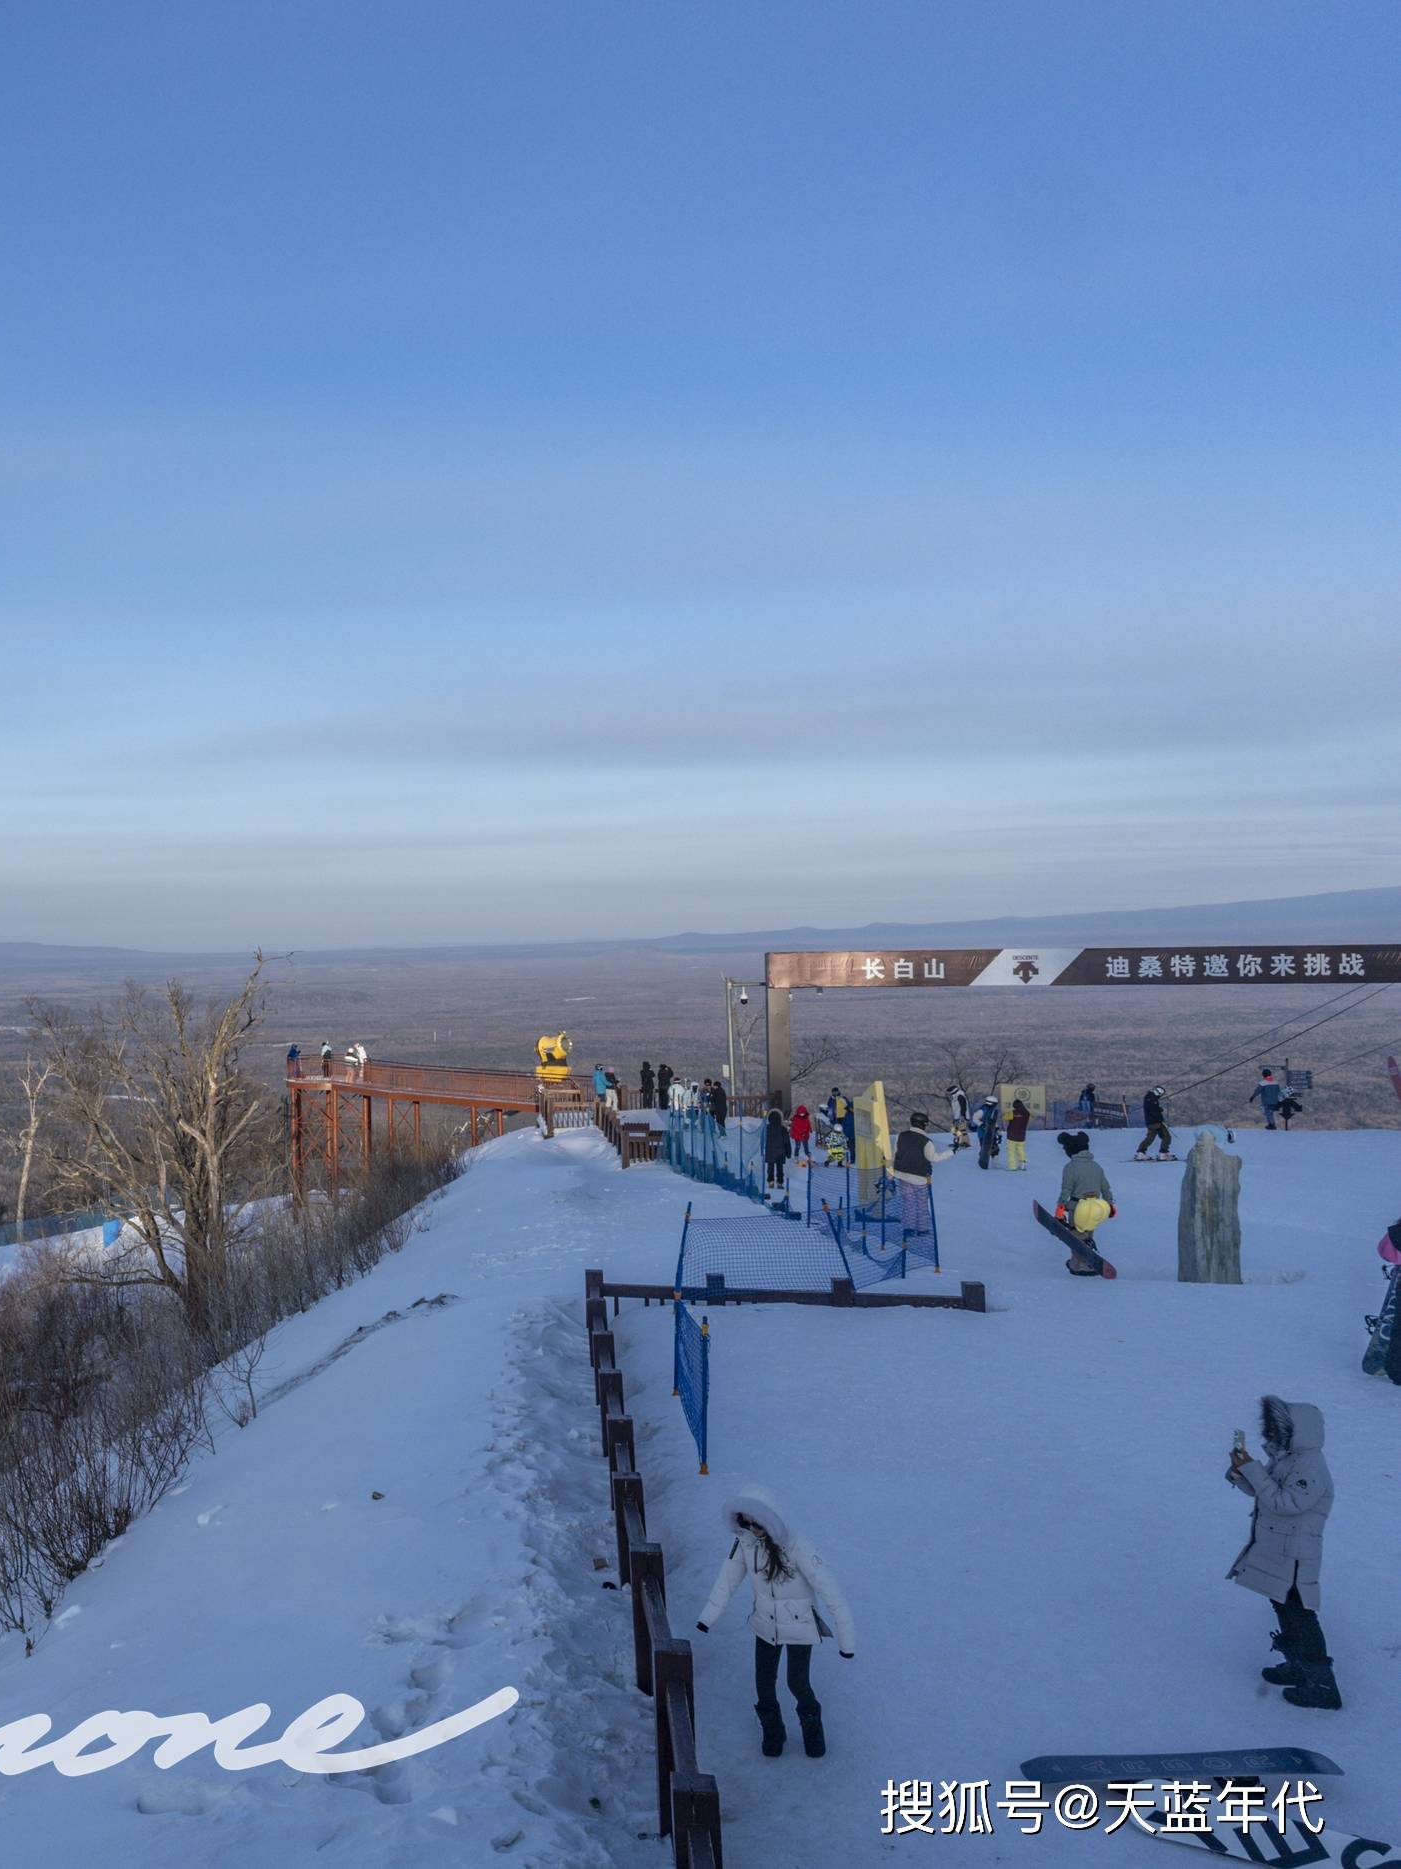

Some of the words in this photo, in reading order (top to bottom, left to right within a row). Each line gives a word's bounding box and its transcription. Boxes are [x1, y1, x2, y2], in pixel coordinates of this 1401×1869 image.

[861, 957, 945, 980] 长白山
[1105, 953, 1365, 978] 迪桑特邀你来挑战
